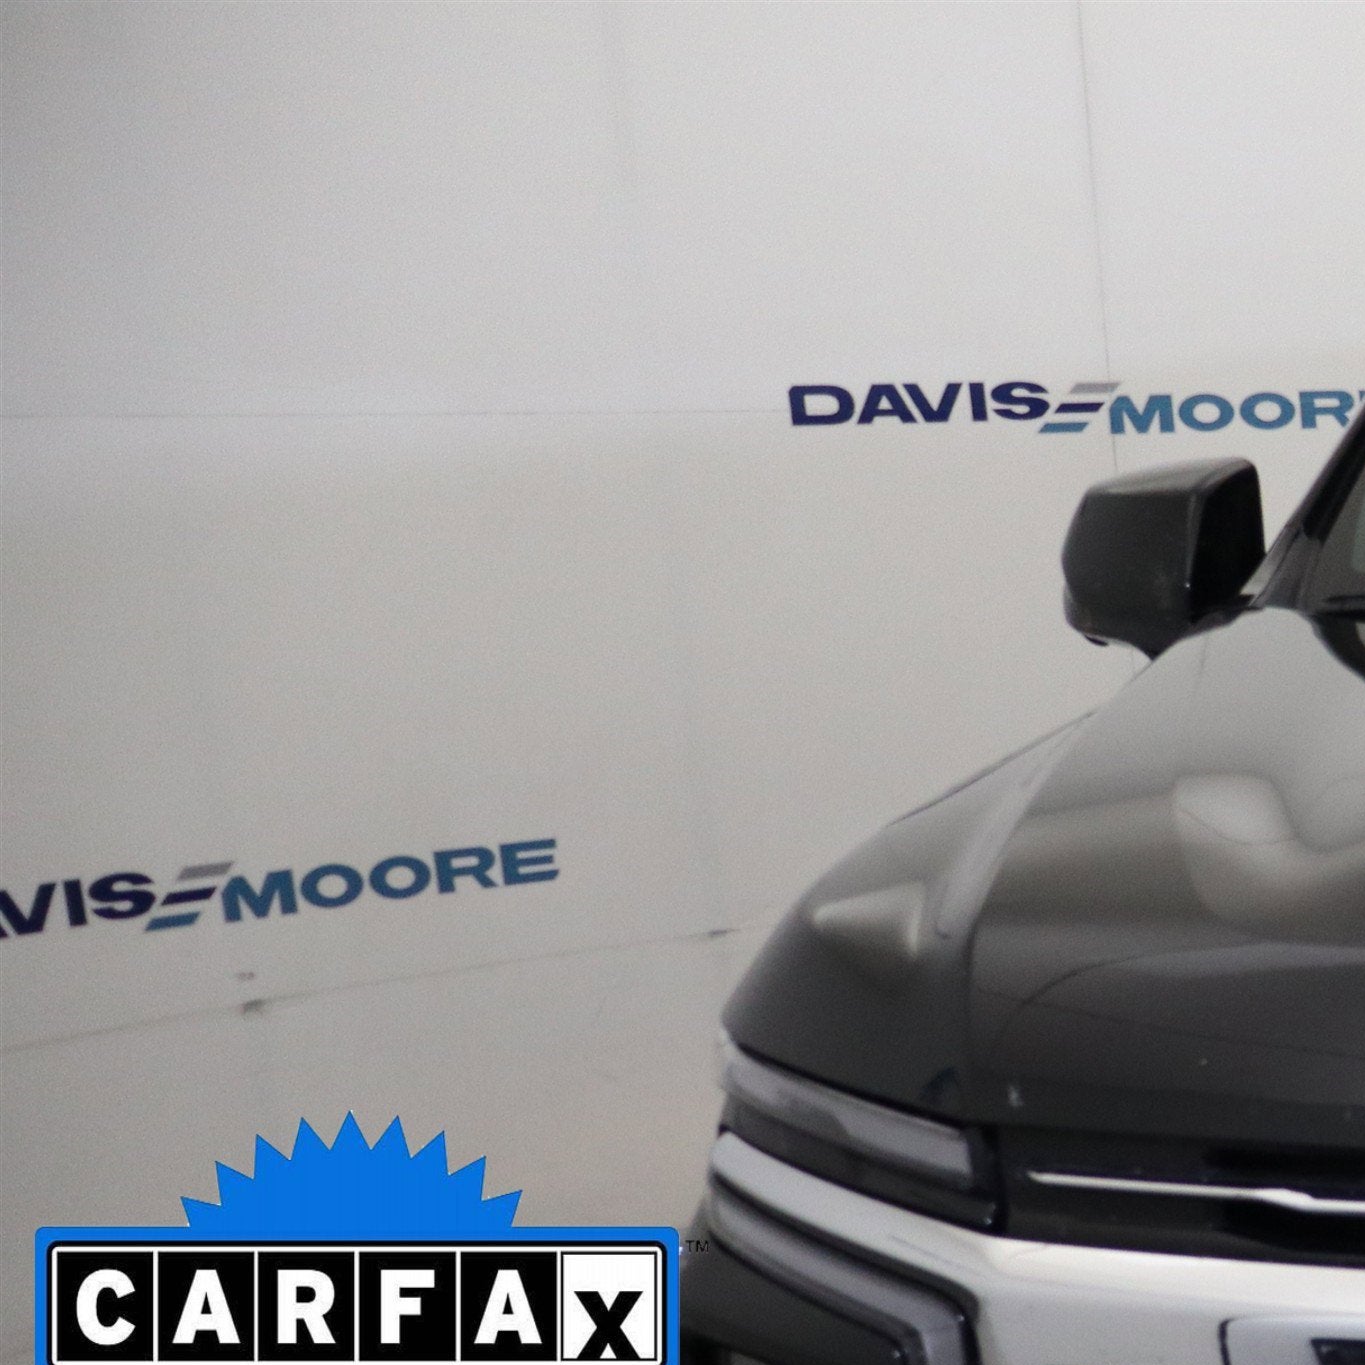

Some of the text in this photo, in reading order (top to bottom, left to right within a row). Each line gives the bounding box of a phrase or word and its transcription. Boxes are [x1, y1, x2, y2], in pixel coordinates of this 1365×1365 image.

[788, 382, 1050, 427] DAVIS
[0, 838, 560, 938] VIS MOORE
